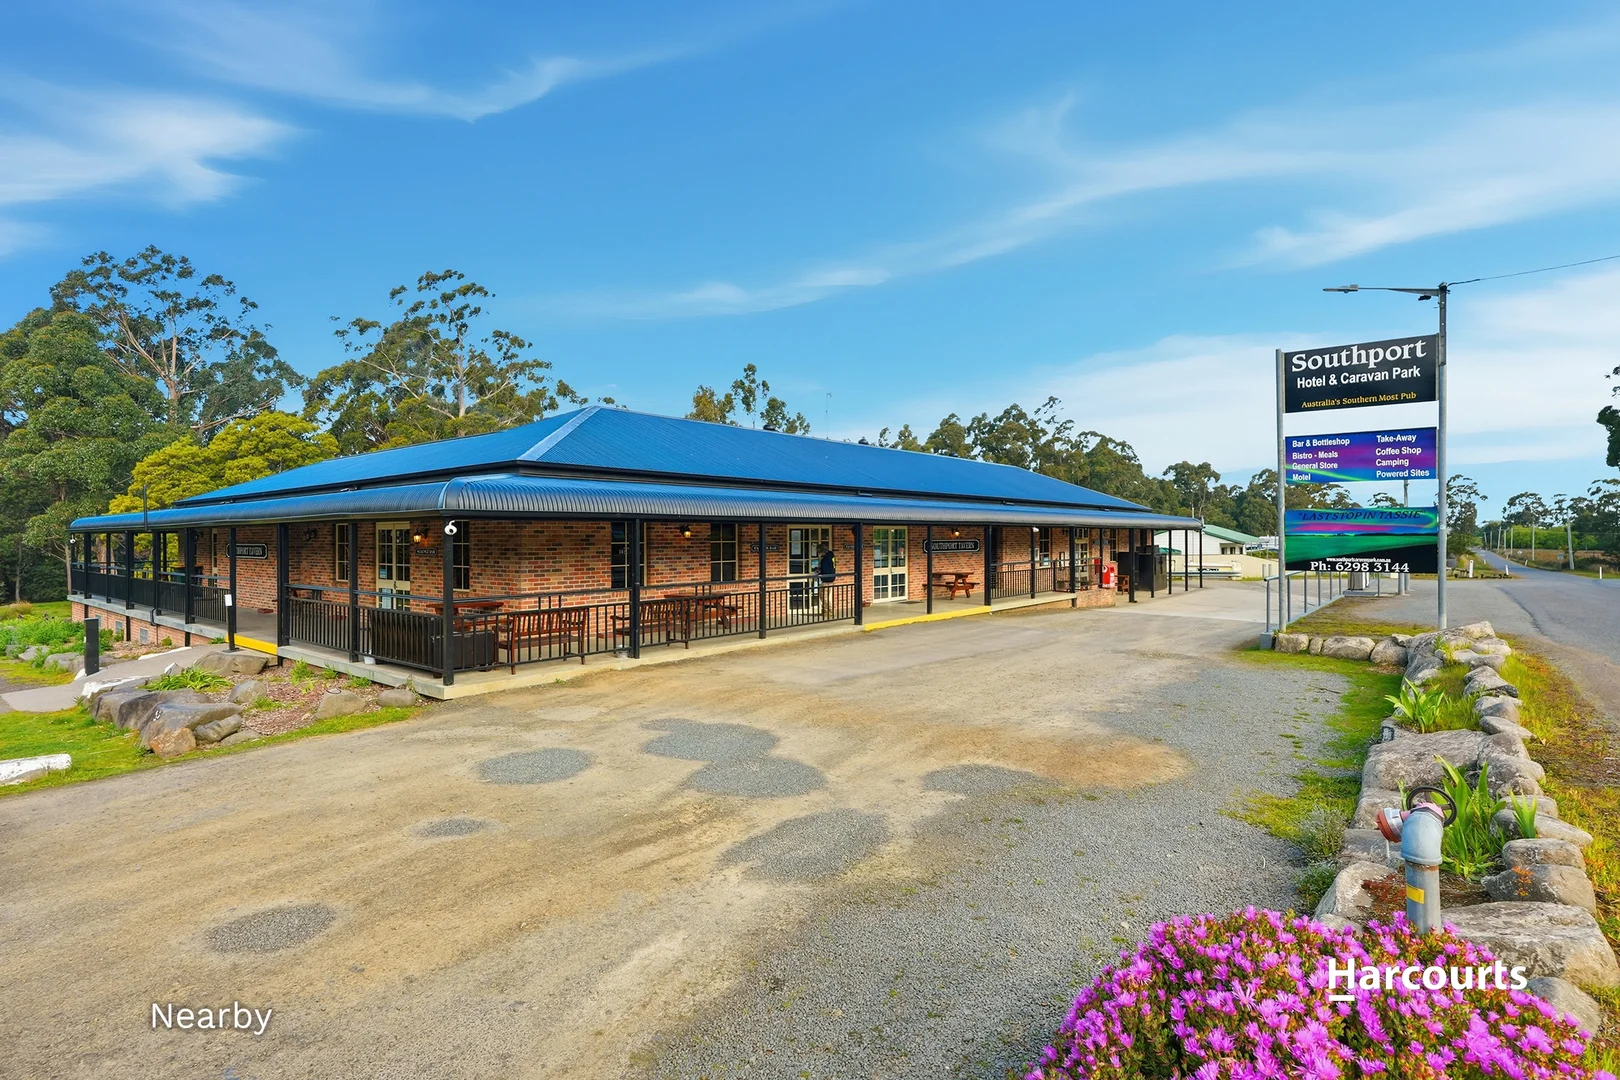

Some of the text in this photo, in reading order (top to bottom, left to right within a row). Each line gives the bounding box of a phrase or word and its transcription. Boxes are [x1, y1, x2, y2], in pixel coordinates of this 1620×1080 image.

[1291, 339, 1427, 372] Southport
[1297, 365, 1421, 389] Hotel & Caravan Park
[1301, 391, 1417, 408] Australia's Southern Most Pub
[1292, 438, 1350, 448] Bar & Bottleshop
[1376, 434, 1417, 443] Take-Away
[1292, 452, 1313, 460] Bistro
[1318, 451, 1338, 459] Meals
[1375, 446, 1422, 456] Coffee Shop
[1292, 461, 1338, 470] General Store
[1375, 458, 1409, 467] Camping
[1292, 473, 1311, 481] Motel
[1376, 469, 1430, 478] Powered Sites
[1332, 511, 1363, 520] STOP
[1362, 511, 1376, 520] IN
[1310, 561, 1410, 573] Ph: 6298 3144
